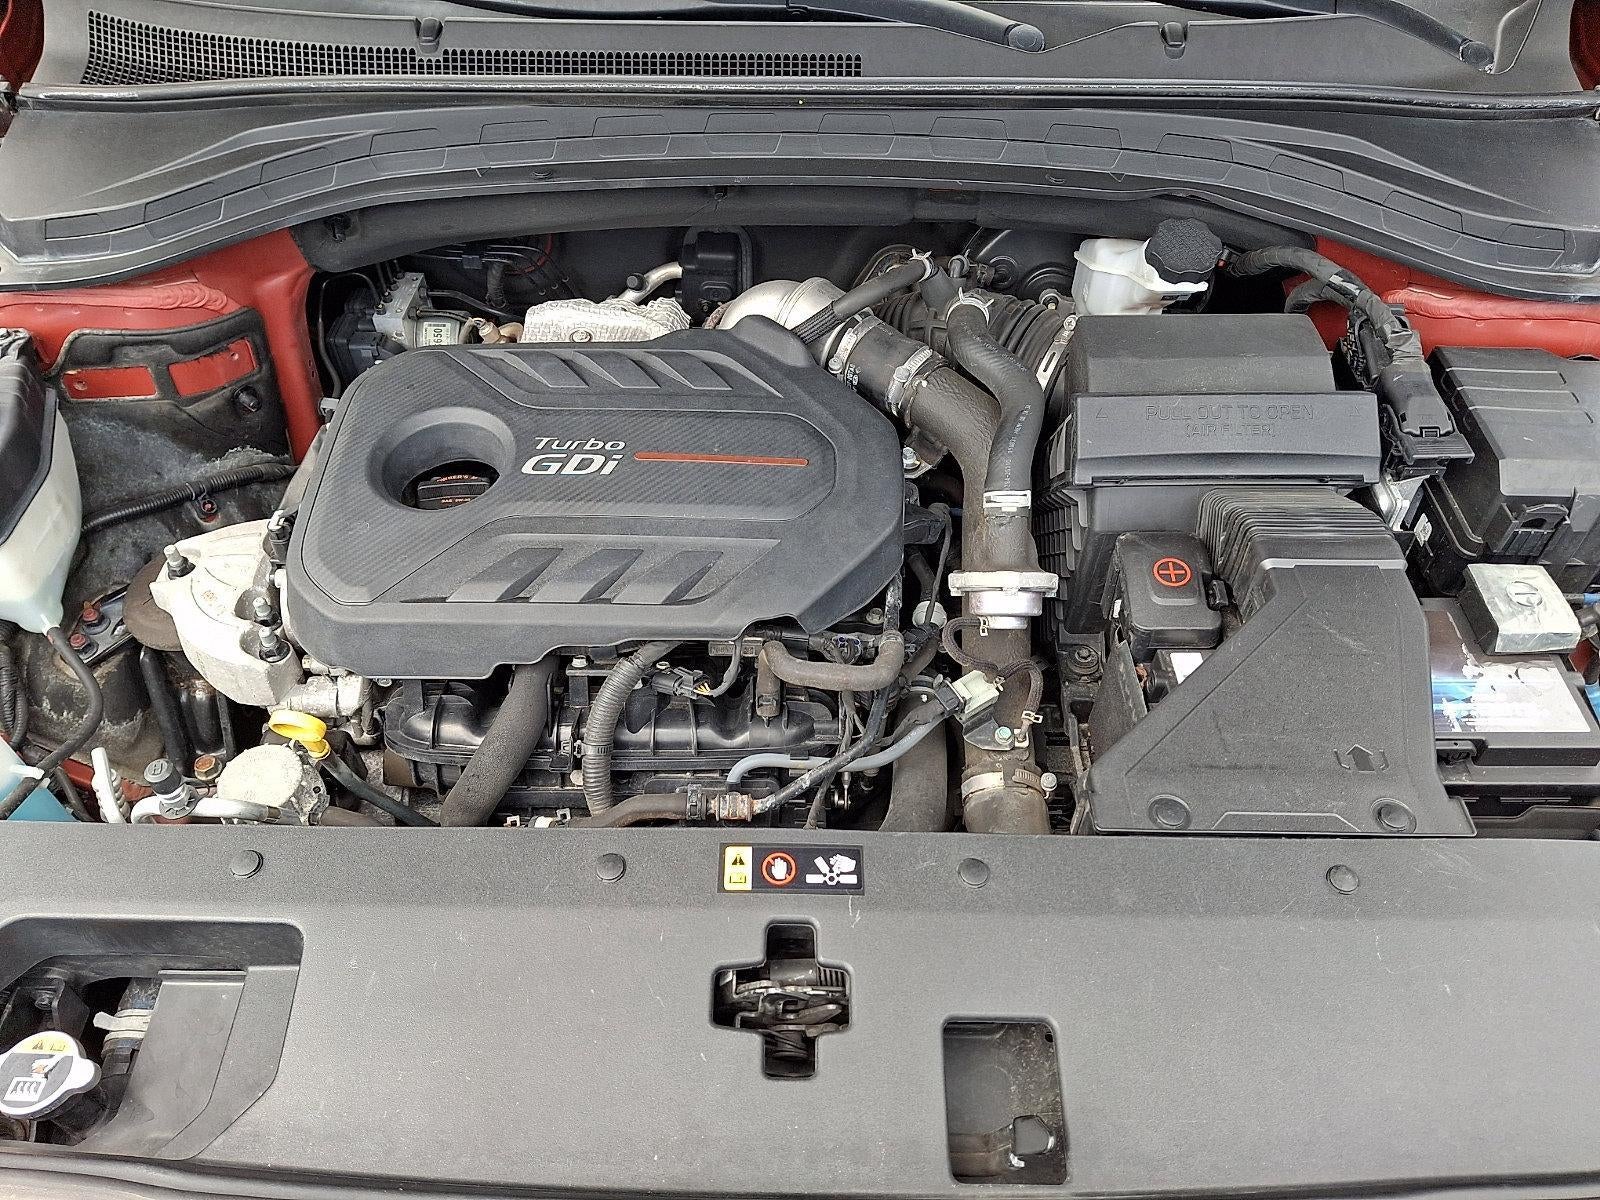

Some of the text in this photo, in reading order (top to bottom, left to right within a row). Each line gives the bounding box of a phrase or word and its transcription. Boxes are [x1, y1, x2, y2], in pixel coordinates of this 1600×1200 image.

[433, 328, 443, 346] 650
[1145, 404, 1314, 421] PULL OUT TO OPEN
[534, 436, 627, 451] Turbo
[521, 453, 624, 475] GDi
